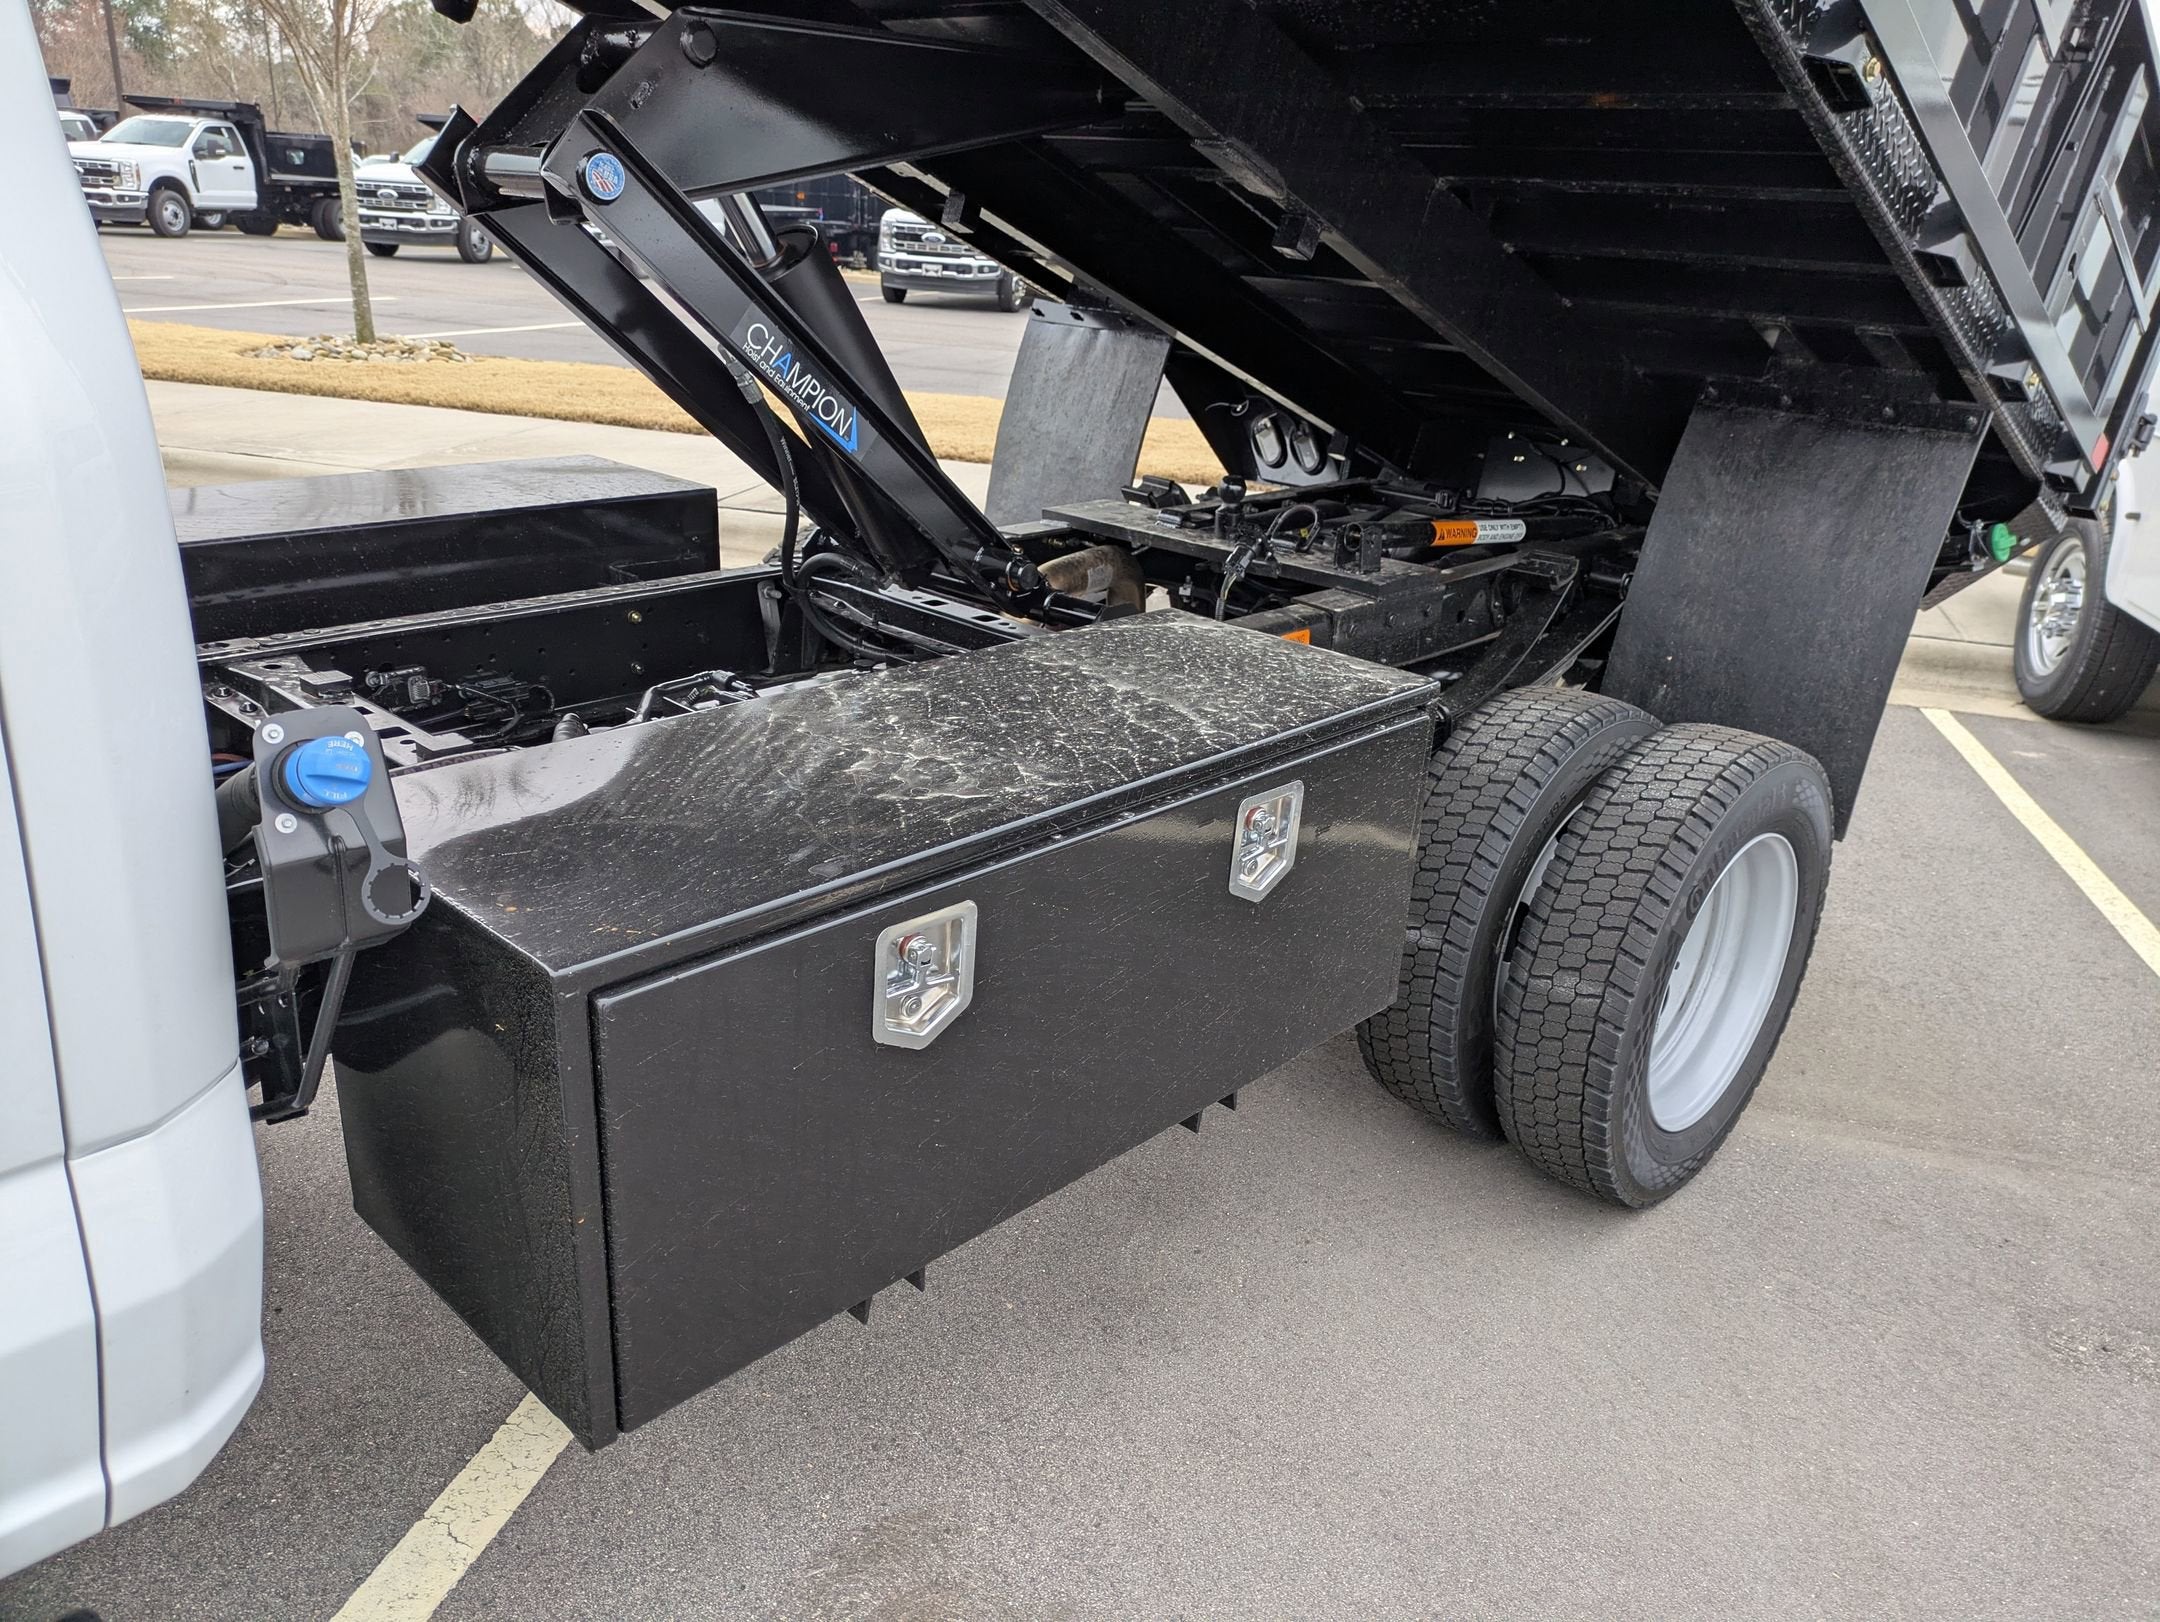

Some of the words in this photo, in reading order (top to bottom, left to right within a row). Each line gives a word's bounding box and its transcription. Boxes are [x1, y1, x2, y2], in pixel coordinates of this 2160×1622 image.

[742, 342, 760, 362] Hoist
[760, 361, 775, 377] and
[774, 375, 811, 412] Equipment
[747, 323, 852, 436] CHAMPION
[1446, 528, 1477, 539] WARNING
[327, 740, 354, 752] HERE
